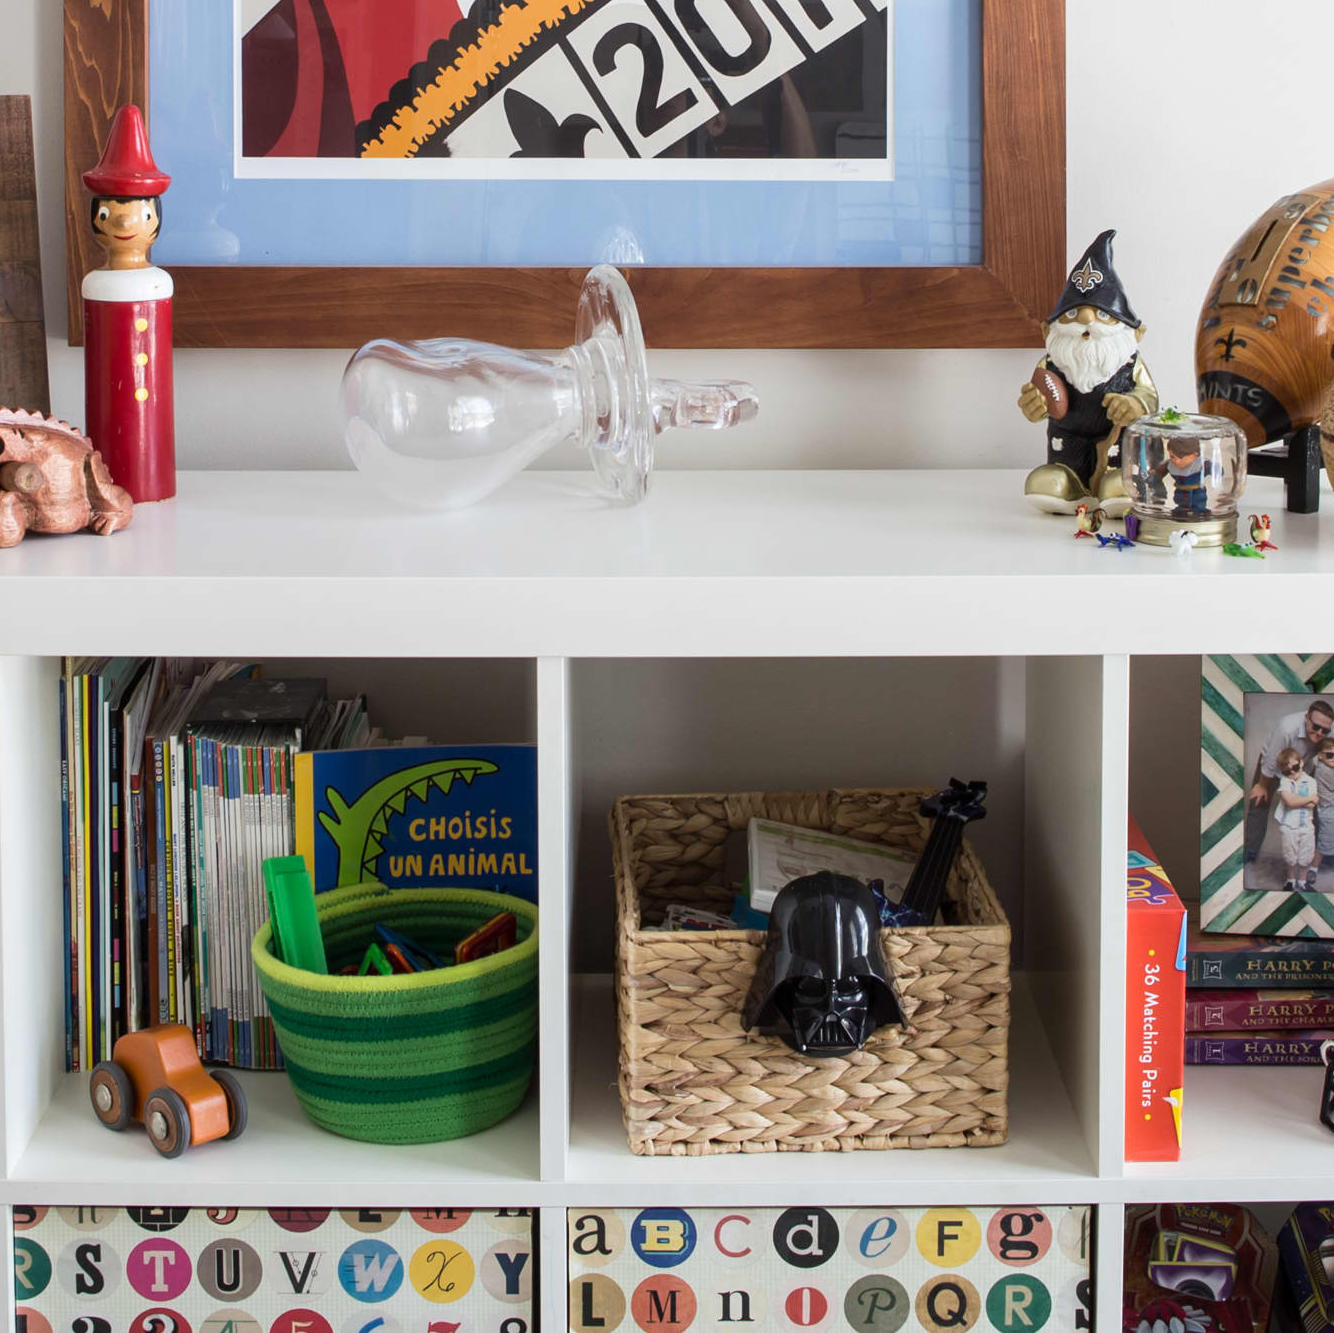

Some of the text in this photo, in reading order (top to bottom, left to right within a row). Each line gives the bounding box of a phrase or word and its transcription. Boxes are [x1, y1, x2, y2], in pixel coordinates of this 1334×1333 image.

[390, 848, 532, 877] UN ANIMAL
[1247, 960, 1315, 971] HARRY
[1250, 1005, 1317, 1016] HARRY
[1243, 1018, 1267, 1026] AND
[1269, 1017, 1291, 1025] THE
[1139, 964, 1160, 1107] 36 Matching Pairs
[1245, 1042, 1315, 1054] HARRY
